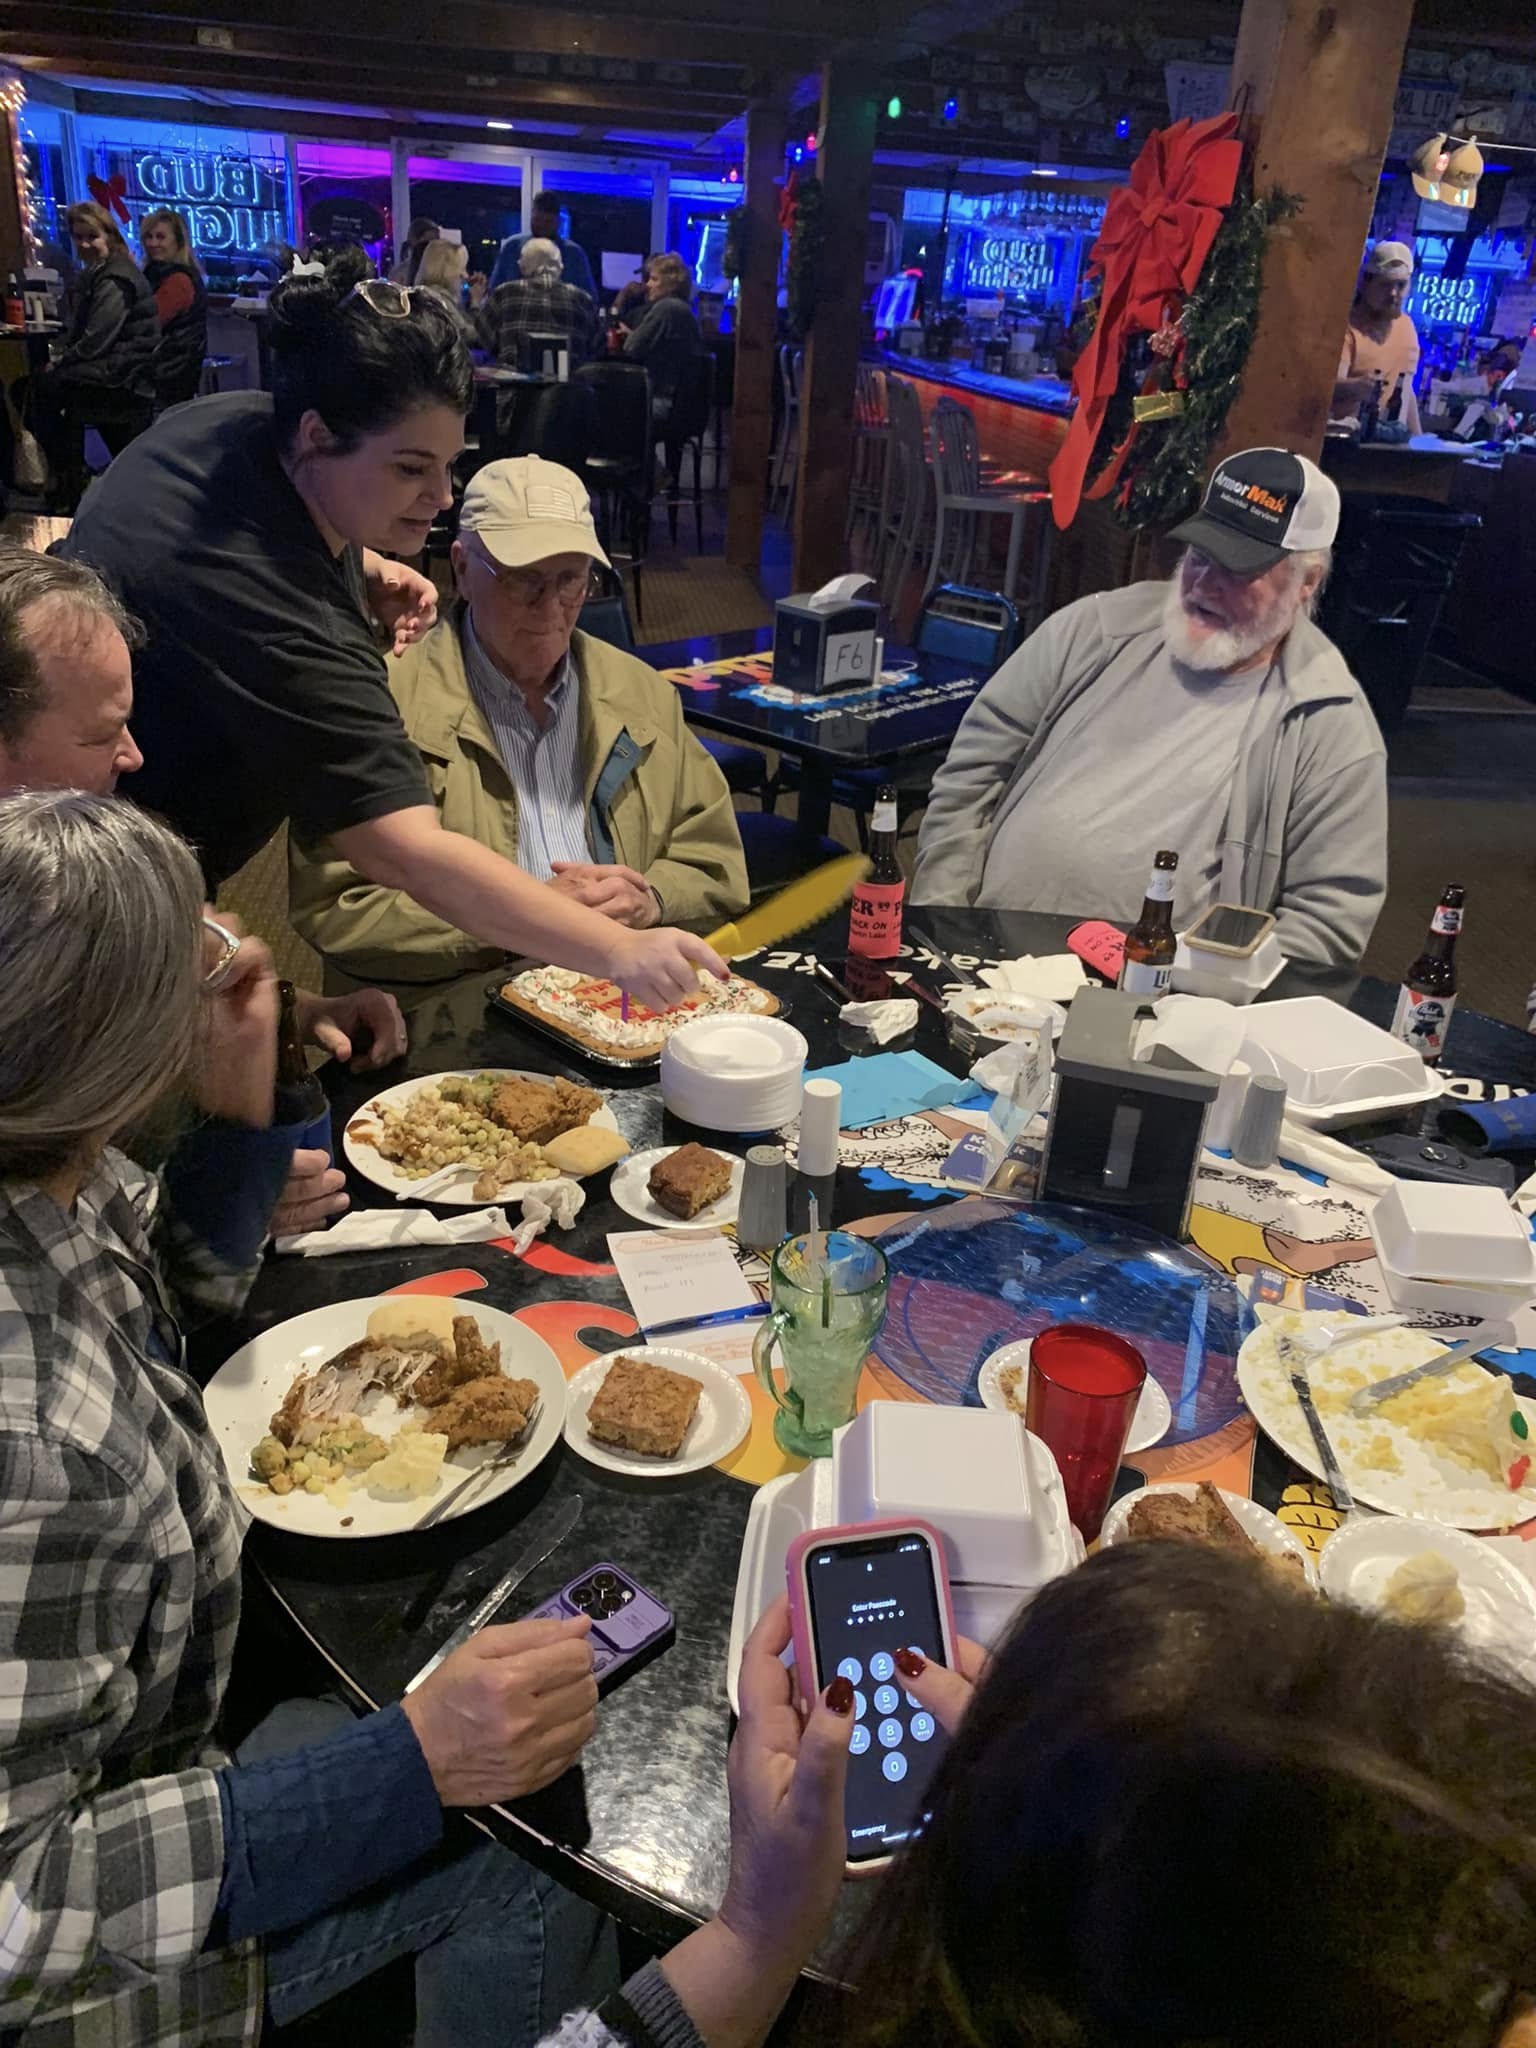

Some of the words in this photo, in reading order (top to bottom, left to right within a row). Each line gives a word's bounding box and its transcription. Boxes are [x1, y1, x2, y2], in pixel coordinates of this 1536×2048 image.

[1416, 273, 1475, 298] BUD
[835, 643, 863, 672] F6
[878, 1659, 886, 1671] 2
[882, 1692, 890, 1704] 5
[886, 1725, 894, 1737] 8
[918, 1719, 926, 1731] 9
[891, 1761, 898, 1773] 0
